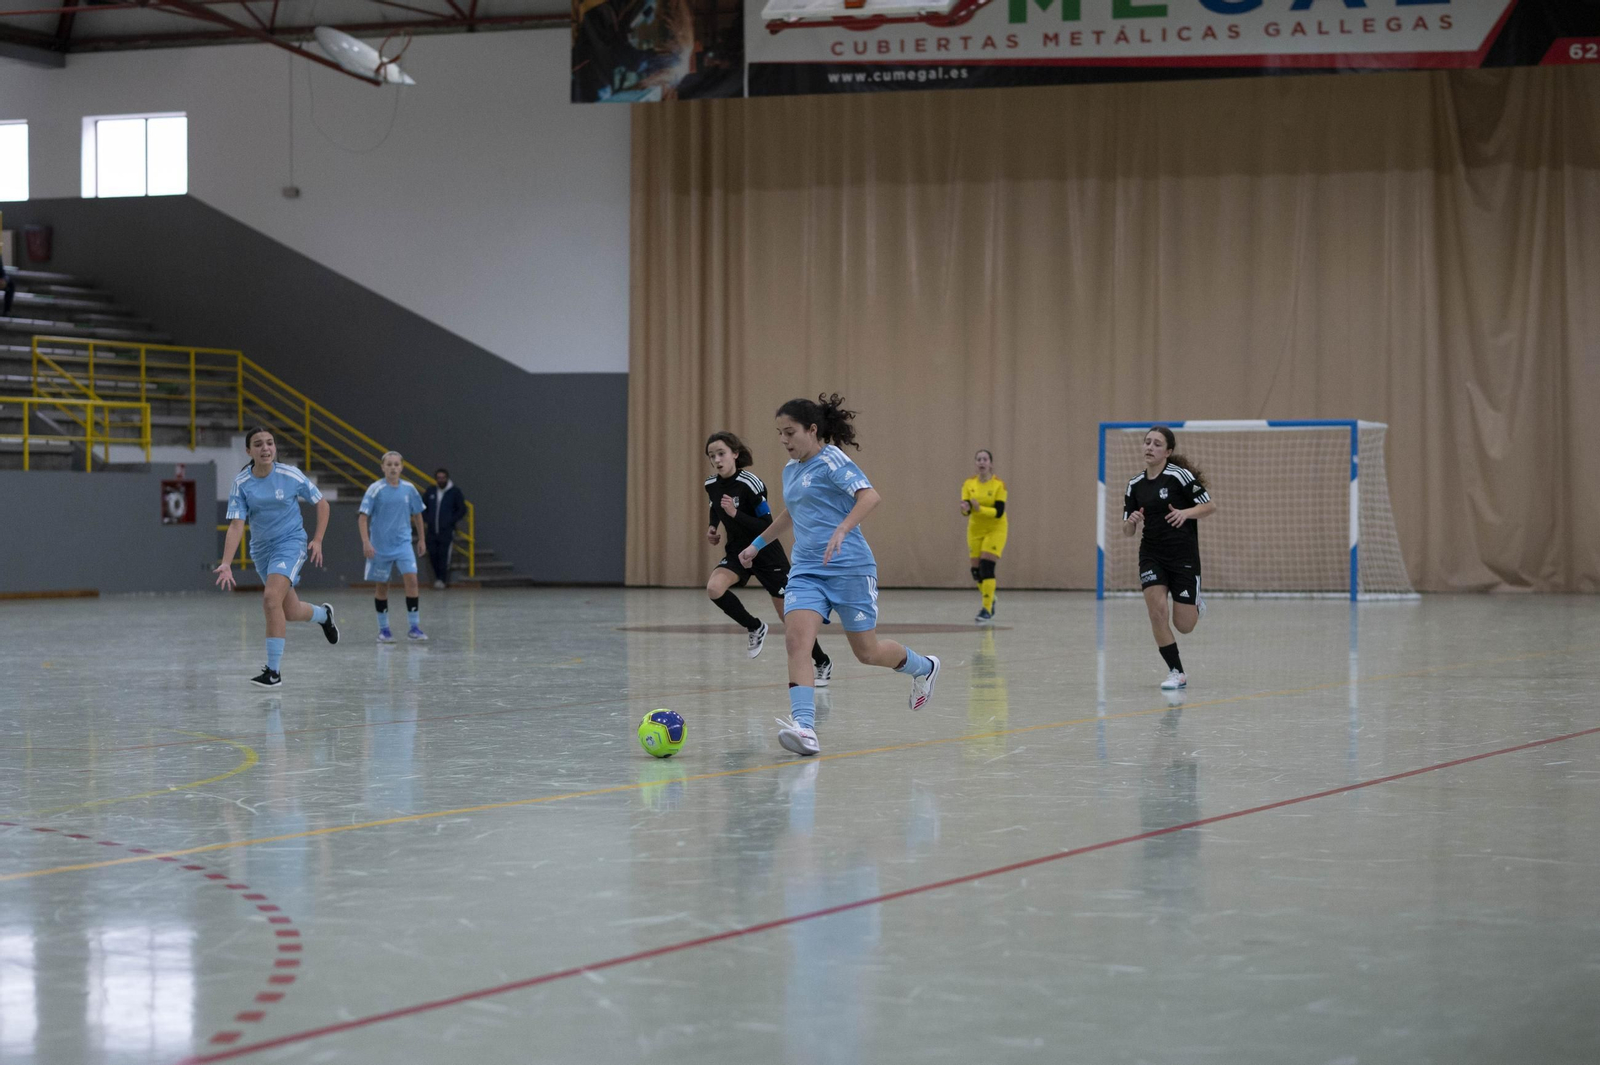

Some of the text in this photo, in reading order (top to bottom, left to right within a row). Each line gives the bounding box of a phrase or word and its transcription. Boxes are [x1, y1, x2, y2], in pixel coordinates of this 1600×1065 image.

[830, 14, 1454, 56] CUBIERTAS METÁLICAS GALLEGAS
[827, 67, 969, 83] www.cumegal.es
